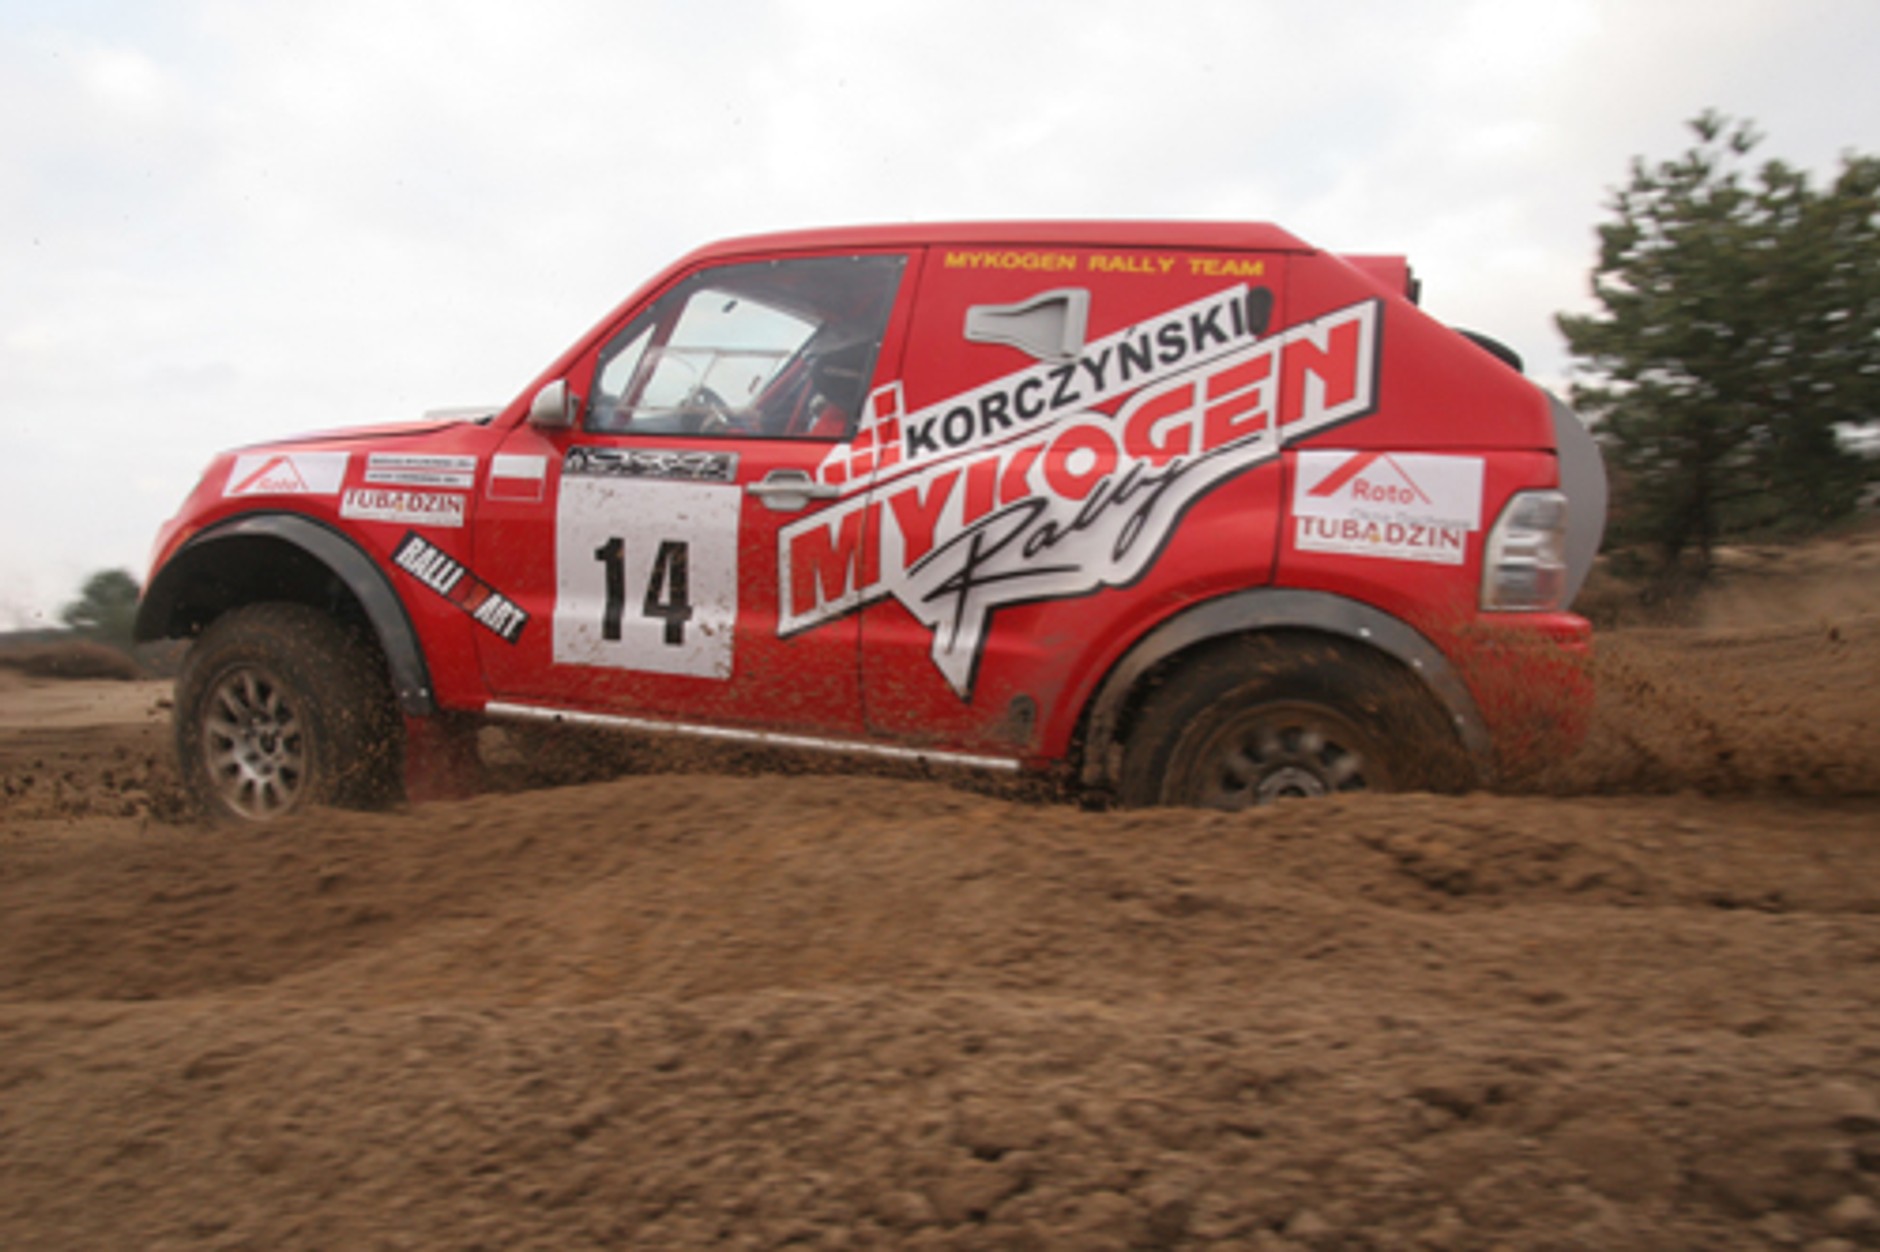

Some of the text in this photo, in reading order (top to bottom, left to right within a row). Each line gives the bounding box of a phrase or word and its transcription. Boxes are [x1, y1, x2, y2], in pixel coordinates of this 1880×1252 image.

[944, 252, 1265, 277] MYKOGEN RALLY TEAM
[906, 297, 1248, 458] KORCZYŃSKI
[790, 319, 1361, 618] MYKOGEN
[1353, 478, 1415, 506] Roto
[594, 537, 693, 646] 14
[907, 433, 1261, 652] Rally
